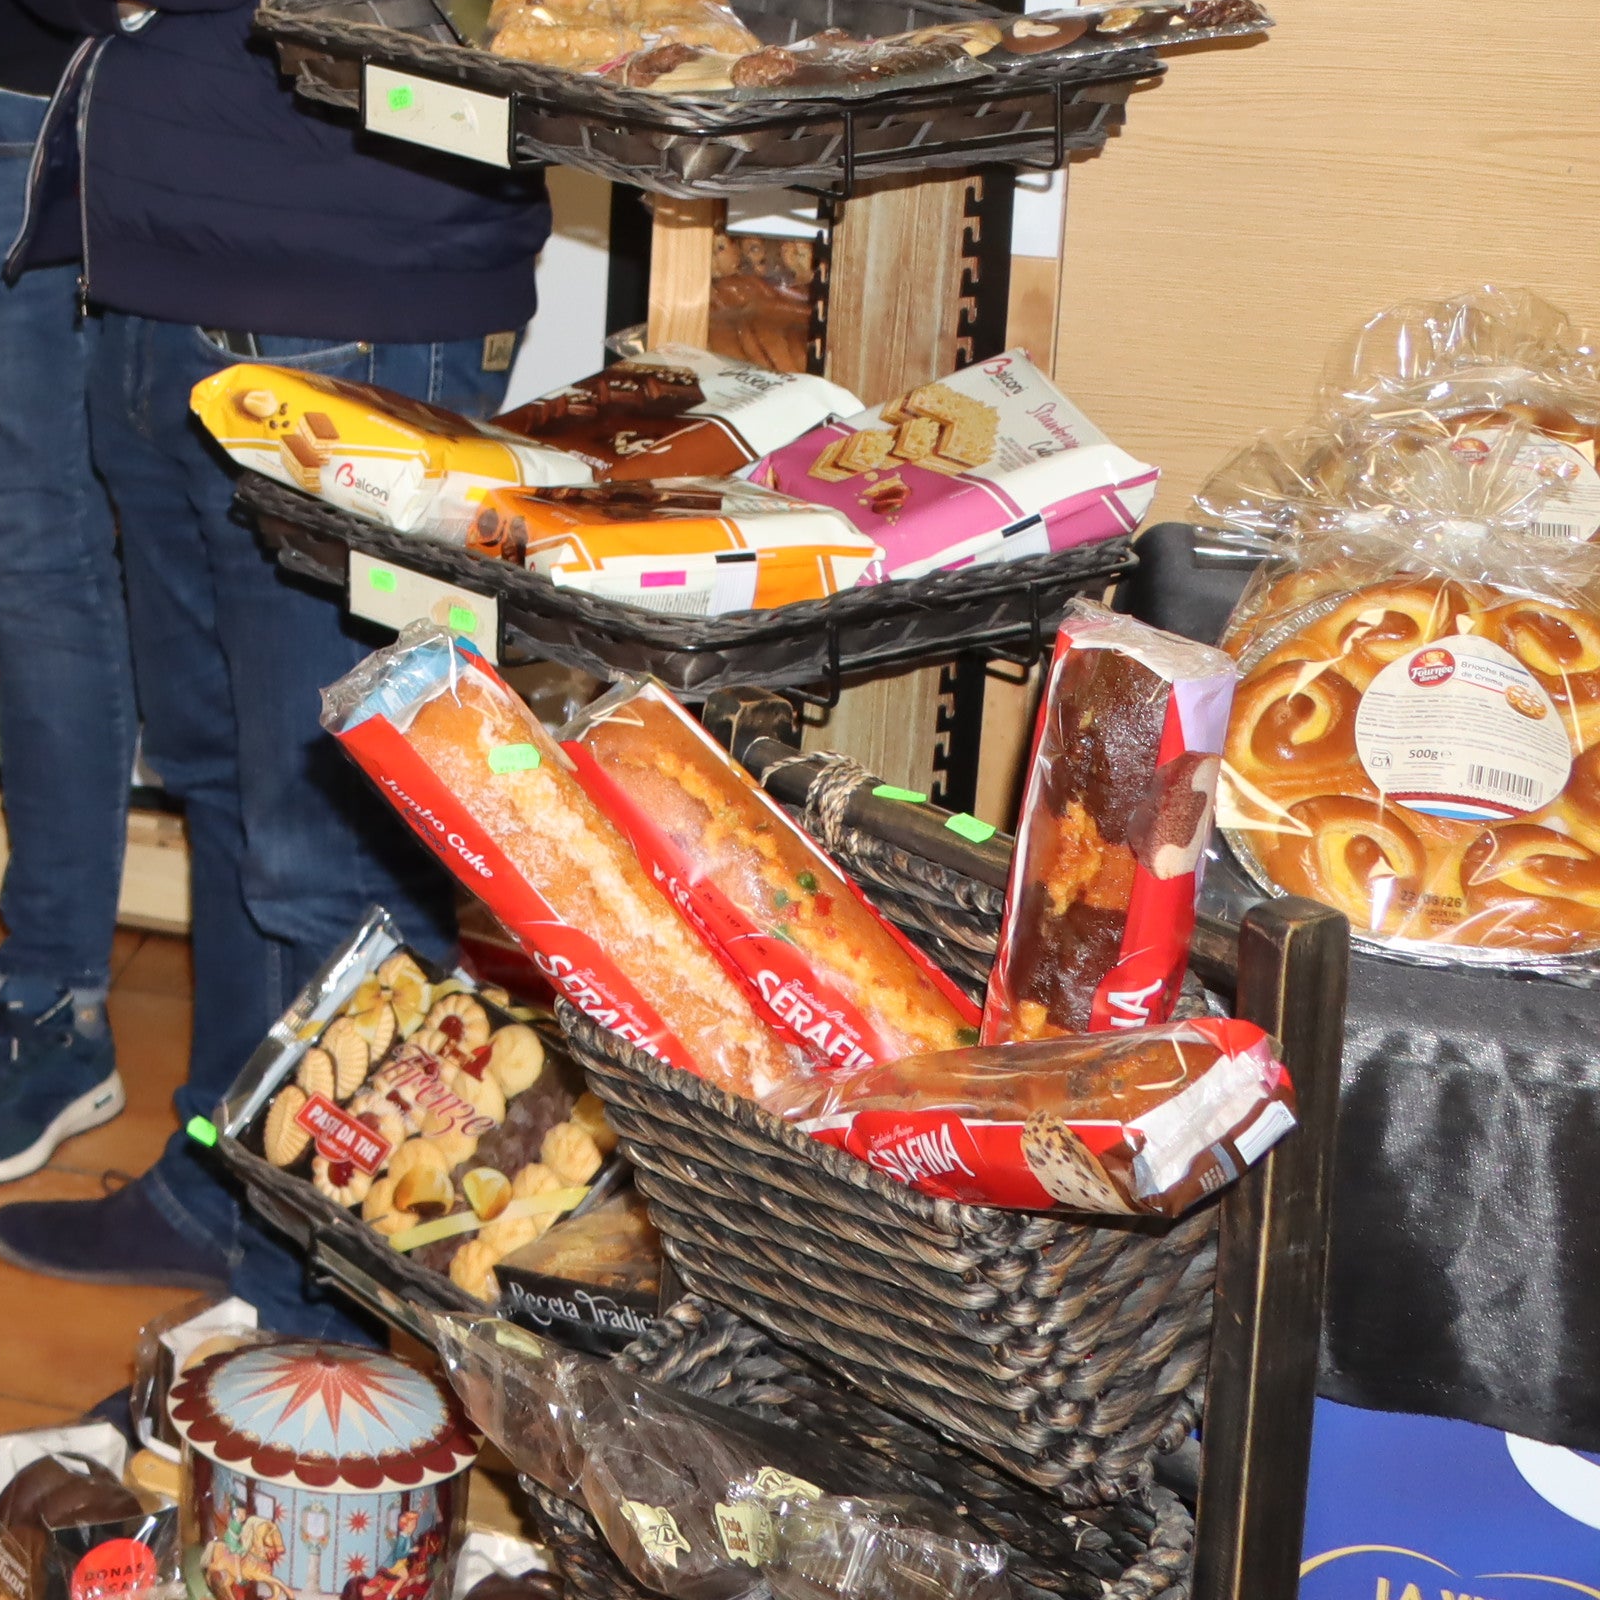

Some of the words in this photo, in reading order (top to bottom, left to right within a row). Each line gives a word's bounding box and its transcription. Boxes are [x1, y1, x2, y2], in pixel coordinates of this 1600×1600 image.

[1461, 660, 1498, 677] Brioche
[1499, 671, 1531, 689] Relleno
[1461, 671, 1474, 679] de
[1474, 673, 1504, 688] Crema
[1408, 749, 1439, 761] 500g
[380, 774, 446, 833] Jumbo
[446, 832, 495, 880] Cake
[335, 1121, 357, 1148] DA
[353, 1136, 382, 1165] THE
[508, 1280, 581, 1326] Receta
